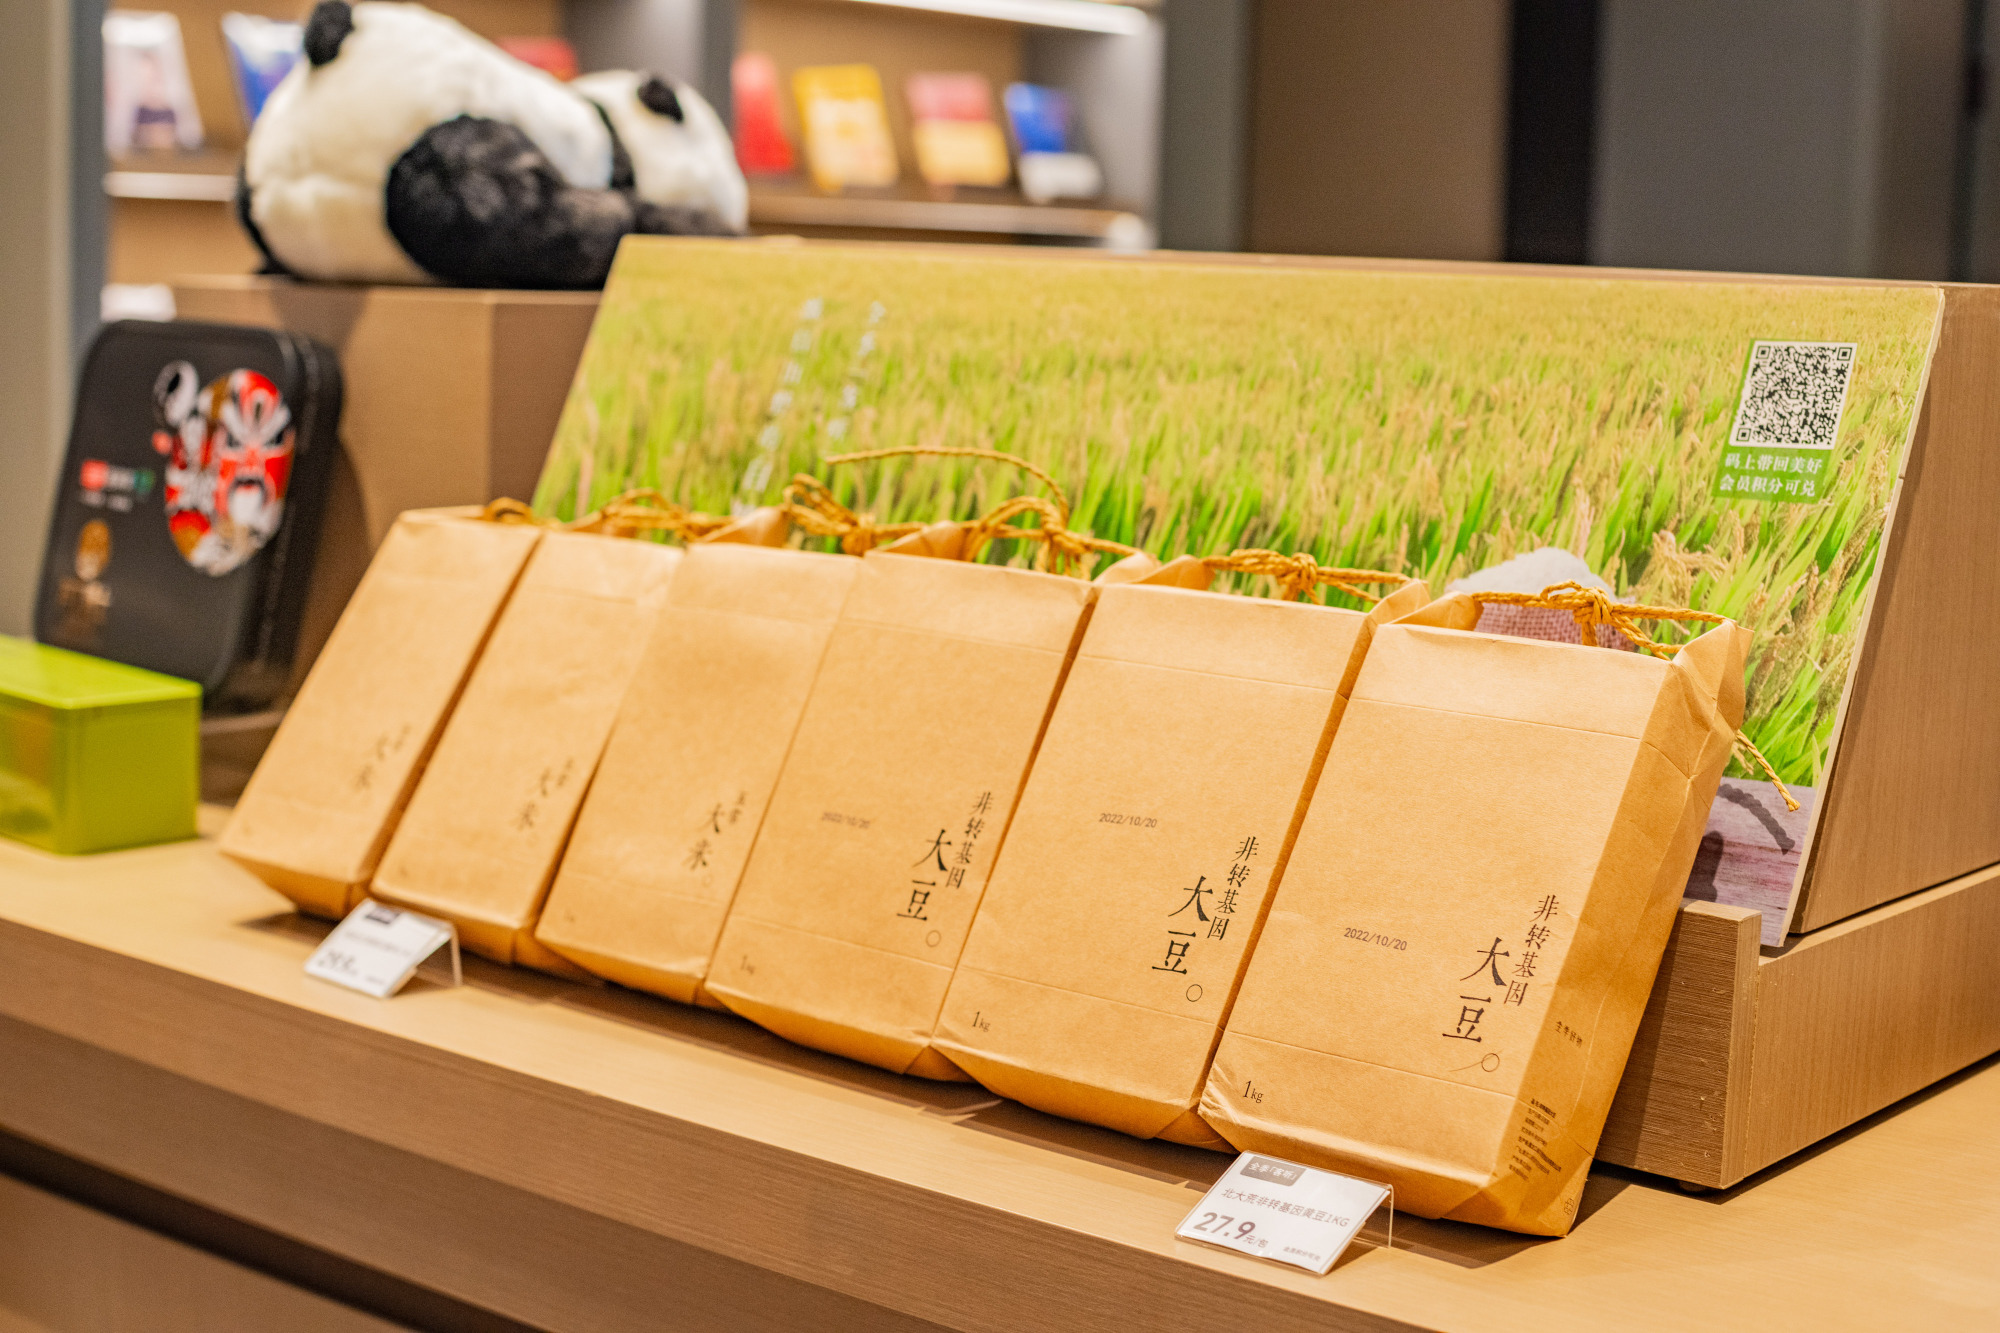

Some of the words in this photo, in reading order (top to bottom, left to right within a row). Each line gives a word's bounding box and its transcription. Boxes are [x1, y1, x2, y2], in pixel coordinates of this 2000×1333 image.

[1725, 452, 1823, 475] 码上带回美好
[1719, 474, 1817, 497] 会员积分可兑
[1099, 812, 1157, 828] 2022/10/20
[945, 791, 993, 889] 非转基因
[1207, 836, 1259, 940] 非转基因
[1343, 927, 1408, 951] 2022/10/20
[1504, 894, 1559, 1006] 非转基因
[972, 1011, 991, 1032] 1kg
[1243, 1080, 1264, 1103] 1kg
[1221, 1187, 1351, 1228] 北大荒非转基因黄豆1KG
